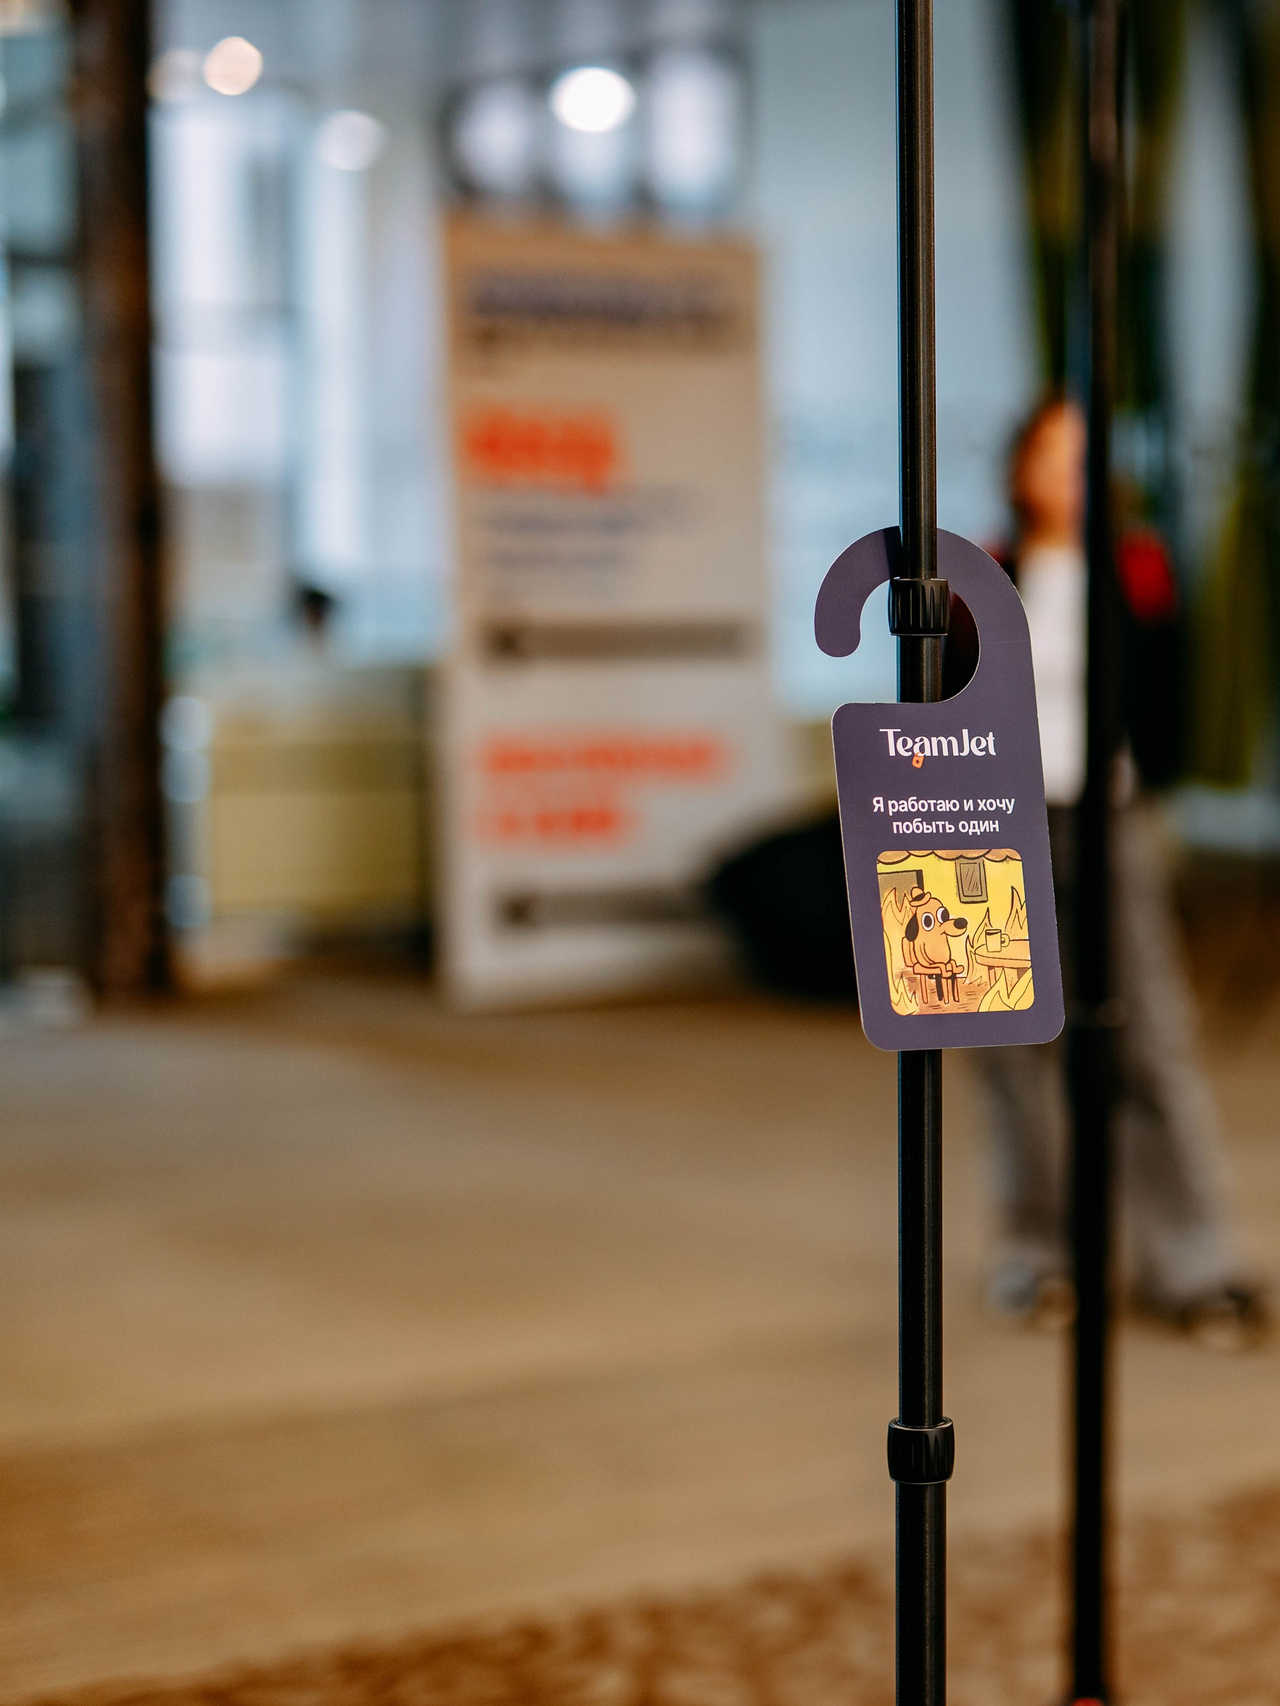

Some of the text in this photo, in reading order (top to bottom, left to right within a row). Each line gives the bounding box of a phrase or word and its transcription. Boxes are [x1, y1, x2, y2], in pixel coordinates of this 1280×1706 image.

[879, 728, 997, 757] TeamJet
[872, 796, 1016, 816] Я работаю и хочу
[892, 818, 1000, 835] побыть один
